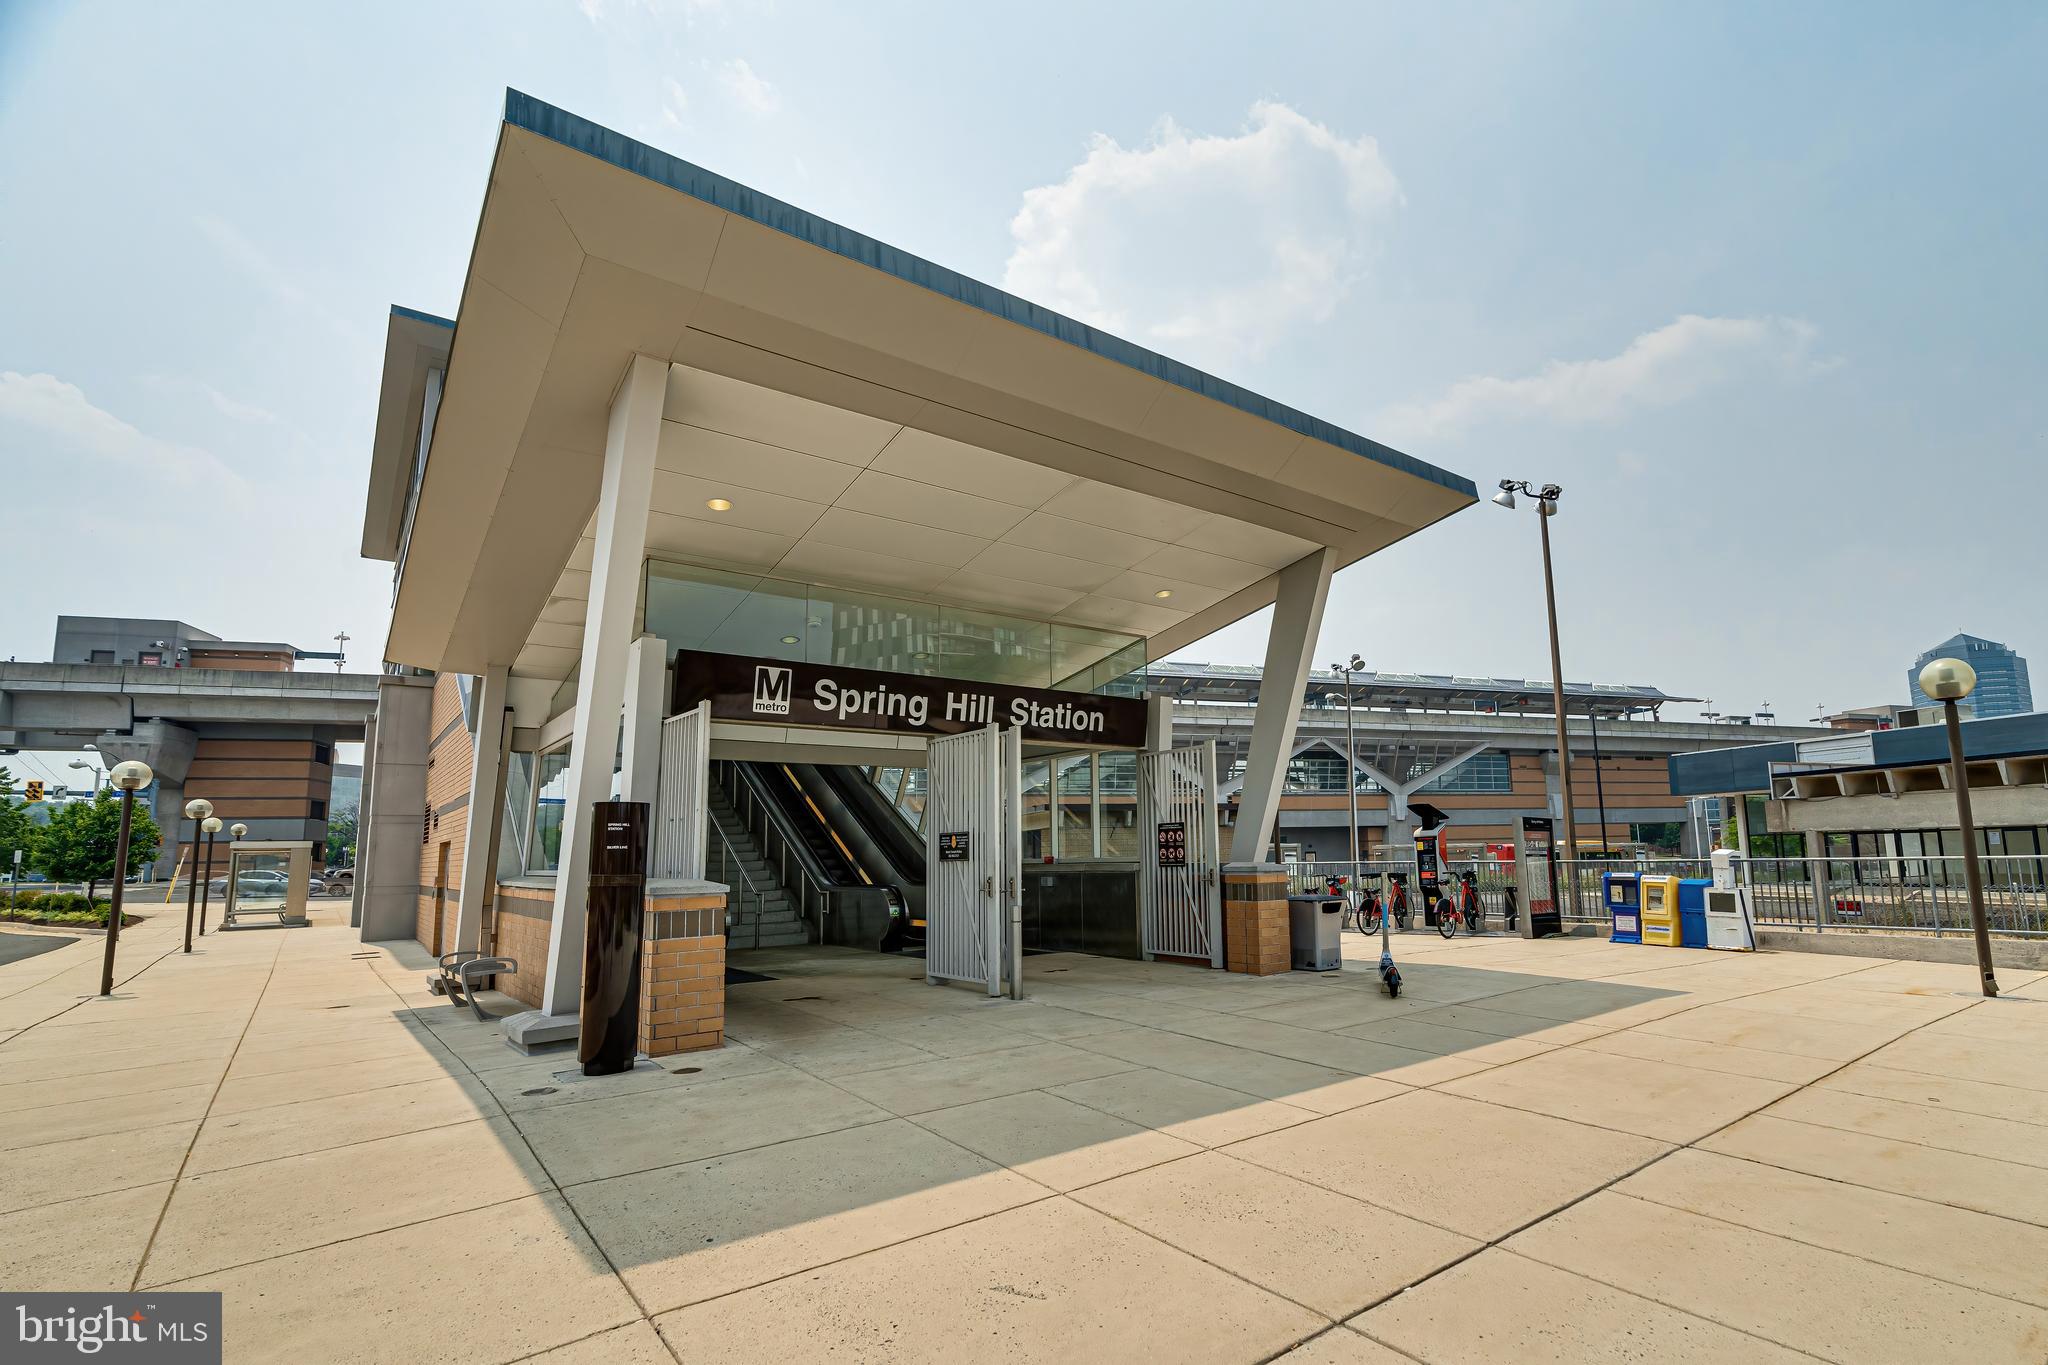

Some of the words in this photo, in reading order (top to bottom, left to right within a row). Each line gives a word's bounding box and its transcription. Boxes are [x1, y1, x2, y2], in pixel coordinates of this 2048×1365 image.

[756, 668, 790, 702] M
[755, 702, 787, 712] metro
[813, 678, 929, 726] Spring
[945, 691, 995, 723] Hill
[1009, 697, 1104, 732] Station
